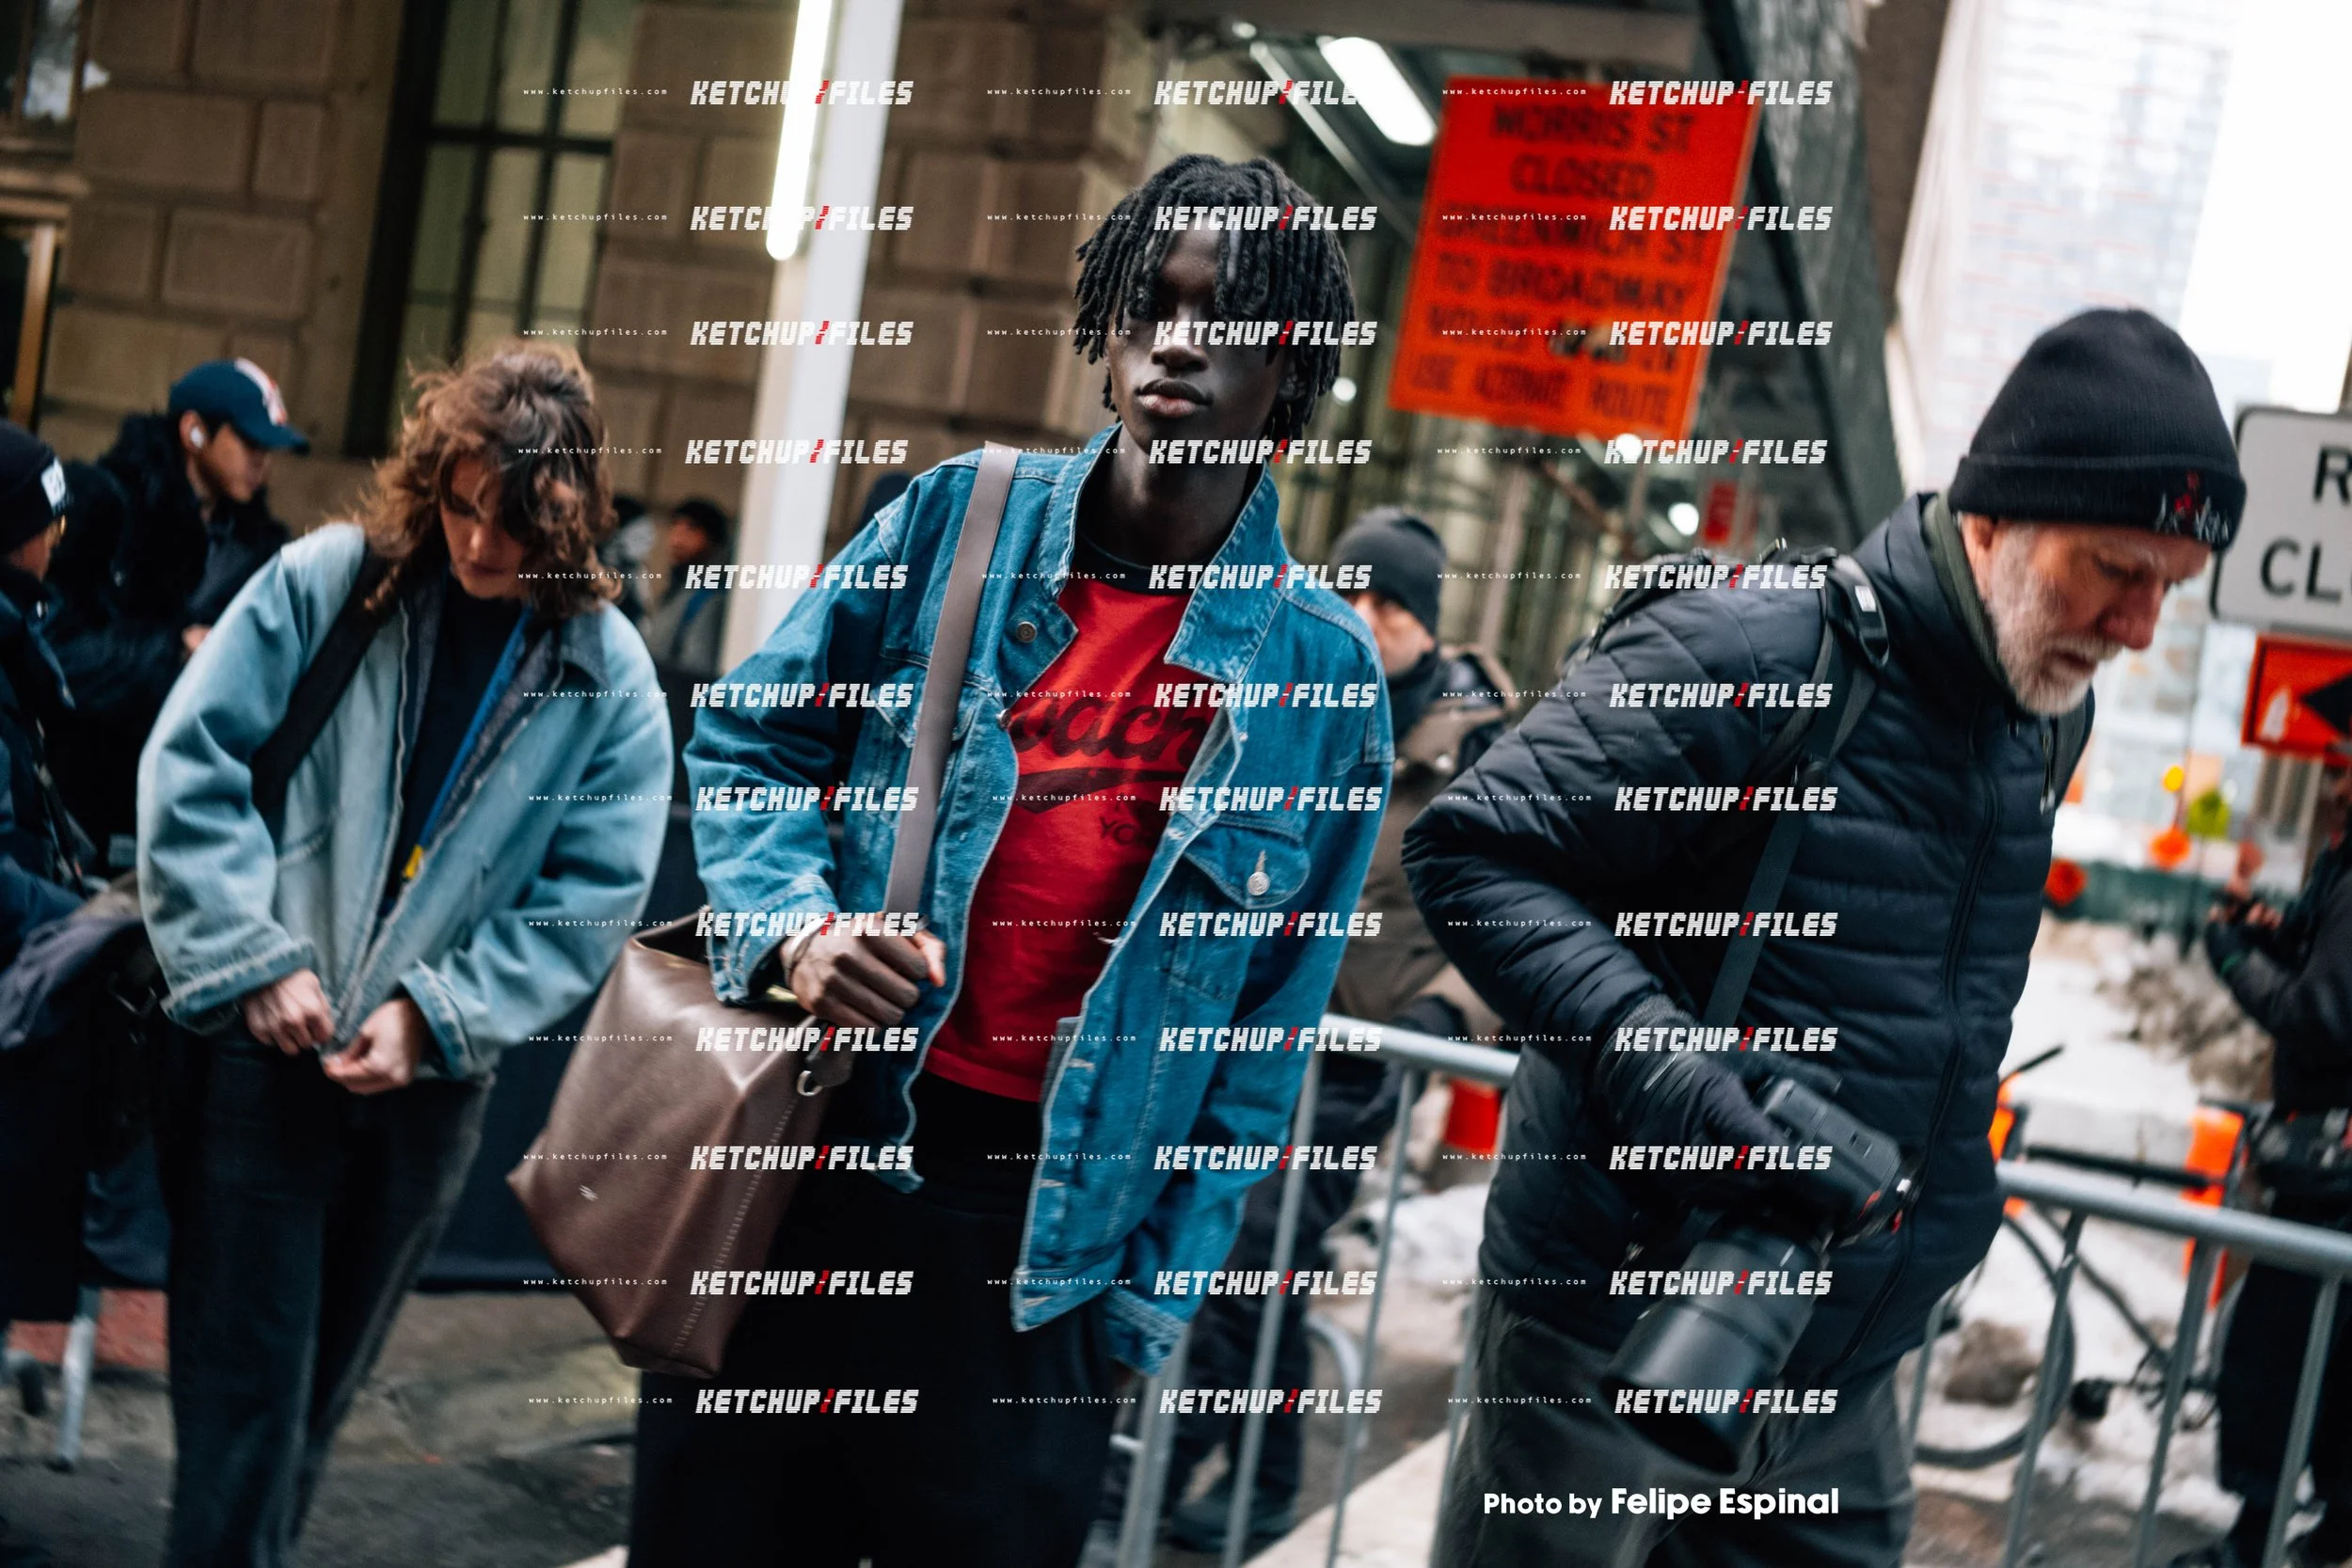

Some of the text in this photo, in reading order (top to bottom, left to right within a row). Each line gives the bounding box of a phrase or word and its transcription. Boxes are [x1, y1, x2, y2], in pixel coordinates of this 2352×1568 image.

[2312, 444, 2352, 503] R
[2260, 536, 2352, 605] CL
[1099, 816, 1136, 846] YO
